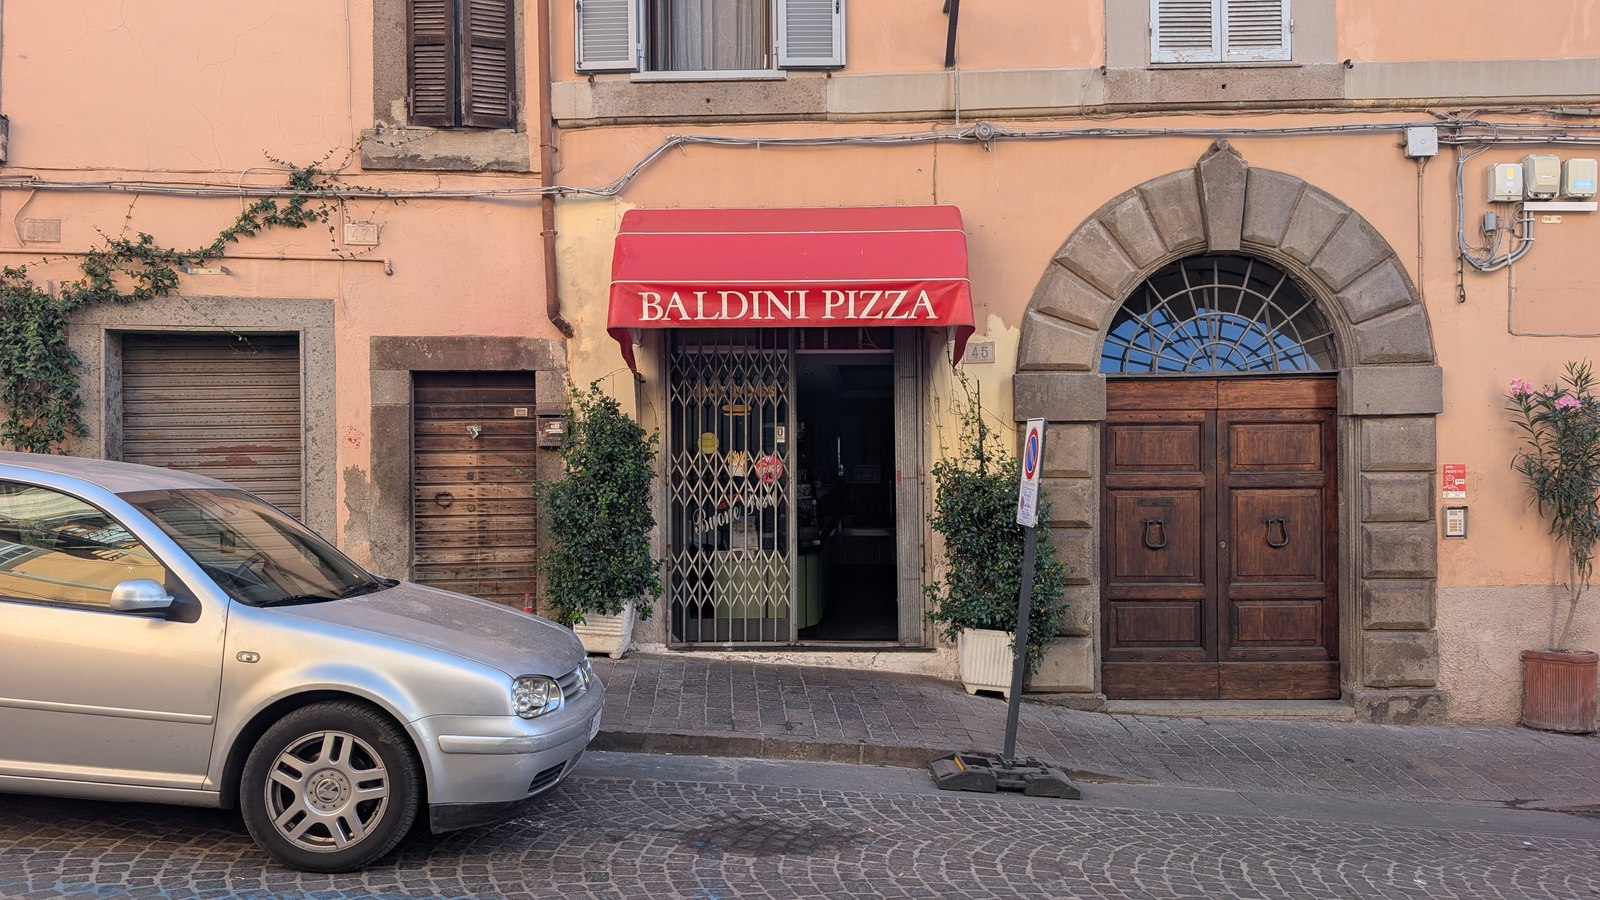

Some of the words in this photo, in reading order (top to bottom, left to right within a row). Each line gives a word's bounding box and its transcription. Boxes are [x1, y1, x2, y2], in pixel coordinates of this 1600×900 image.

[638, 290, 809, 320] BALDINI
[821, 290, 939, 319] PIZZA
[972, 346, 989, 359] 45
